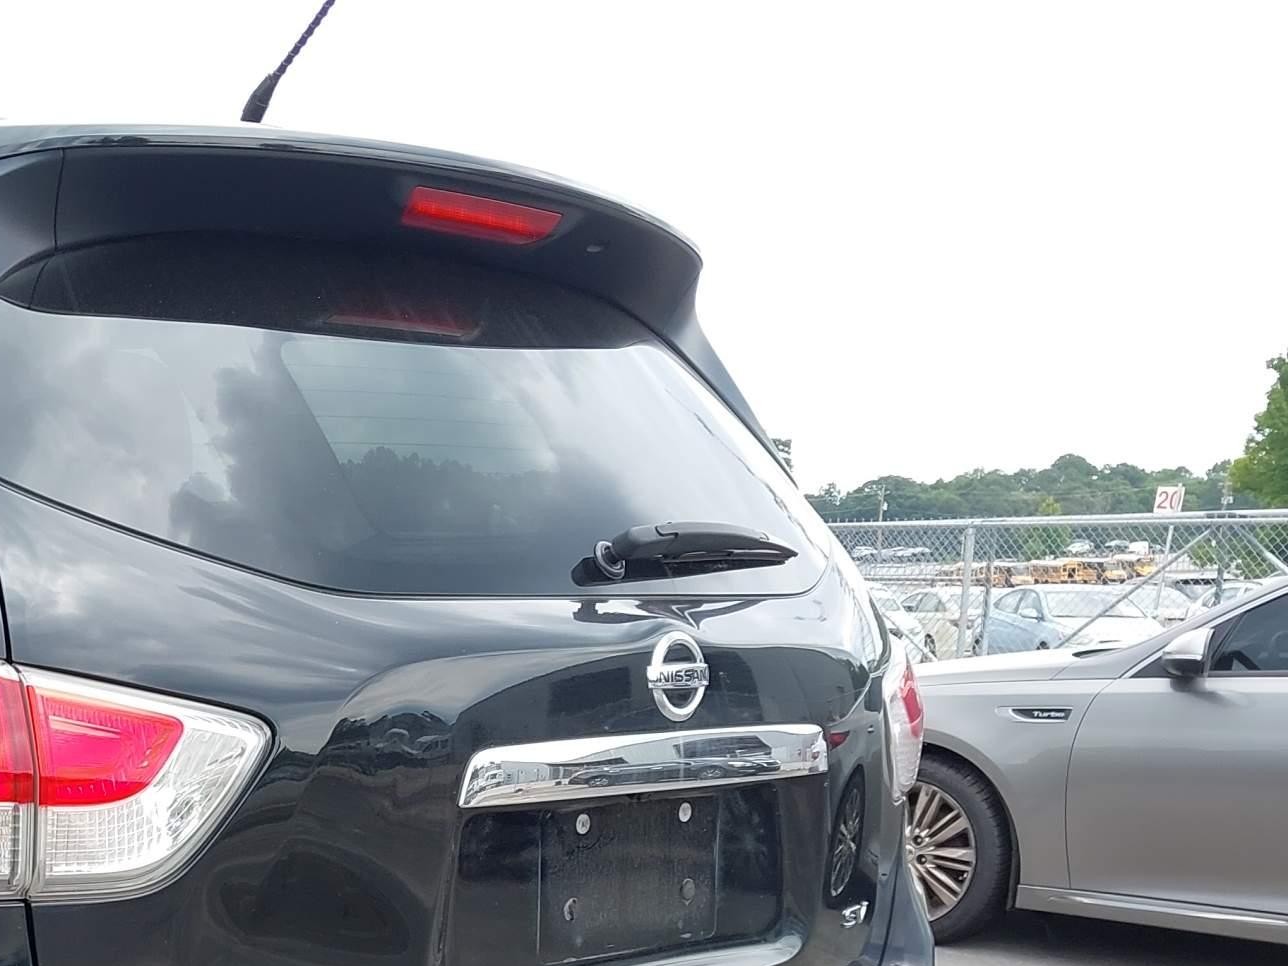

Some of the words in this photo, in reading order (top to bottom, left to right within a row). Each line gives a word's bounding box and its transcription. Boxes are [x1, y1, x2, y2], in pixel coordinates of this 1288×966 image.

[1156, 490, 1182, 510] 20
[659, 667, 709, 683] NISSAN
[1032, 710, 1065, 718] Turbo
